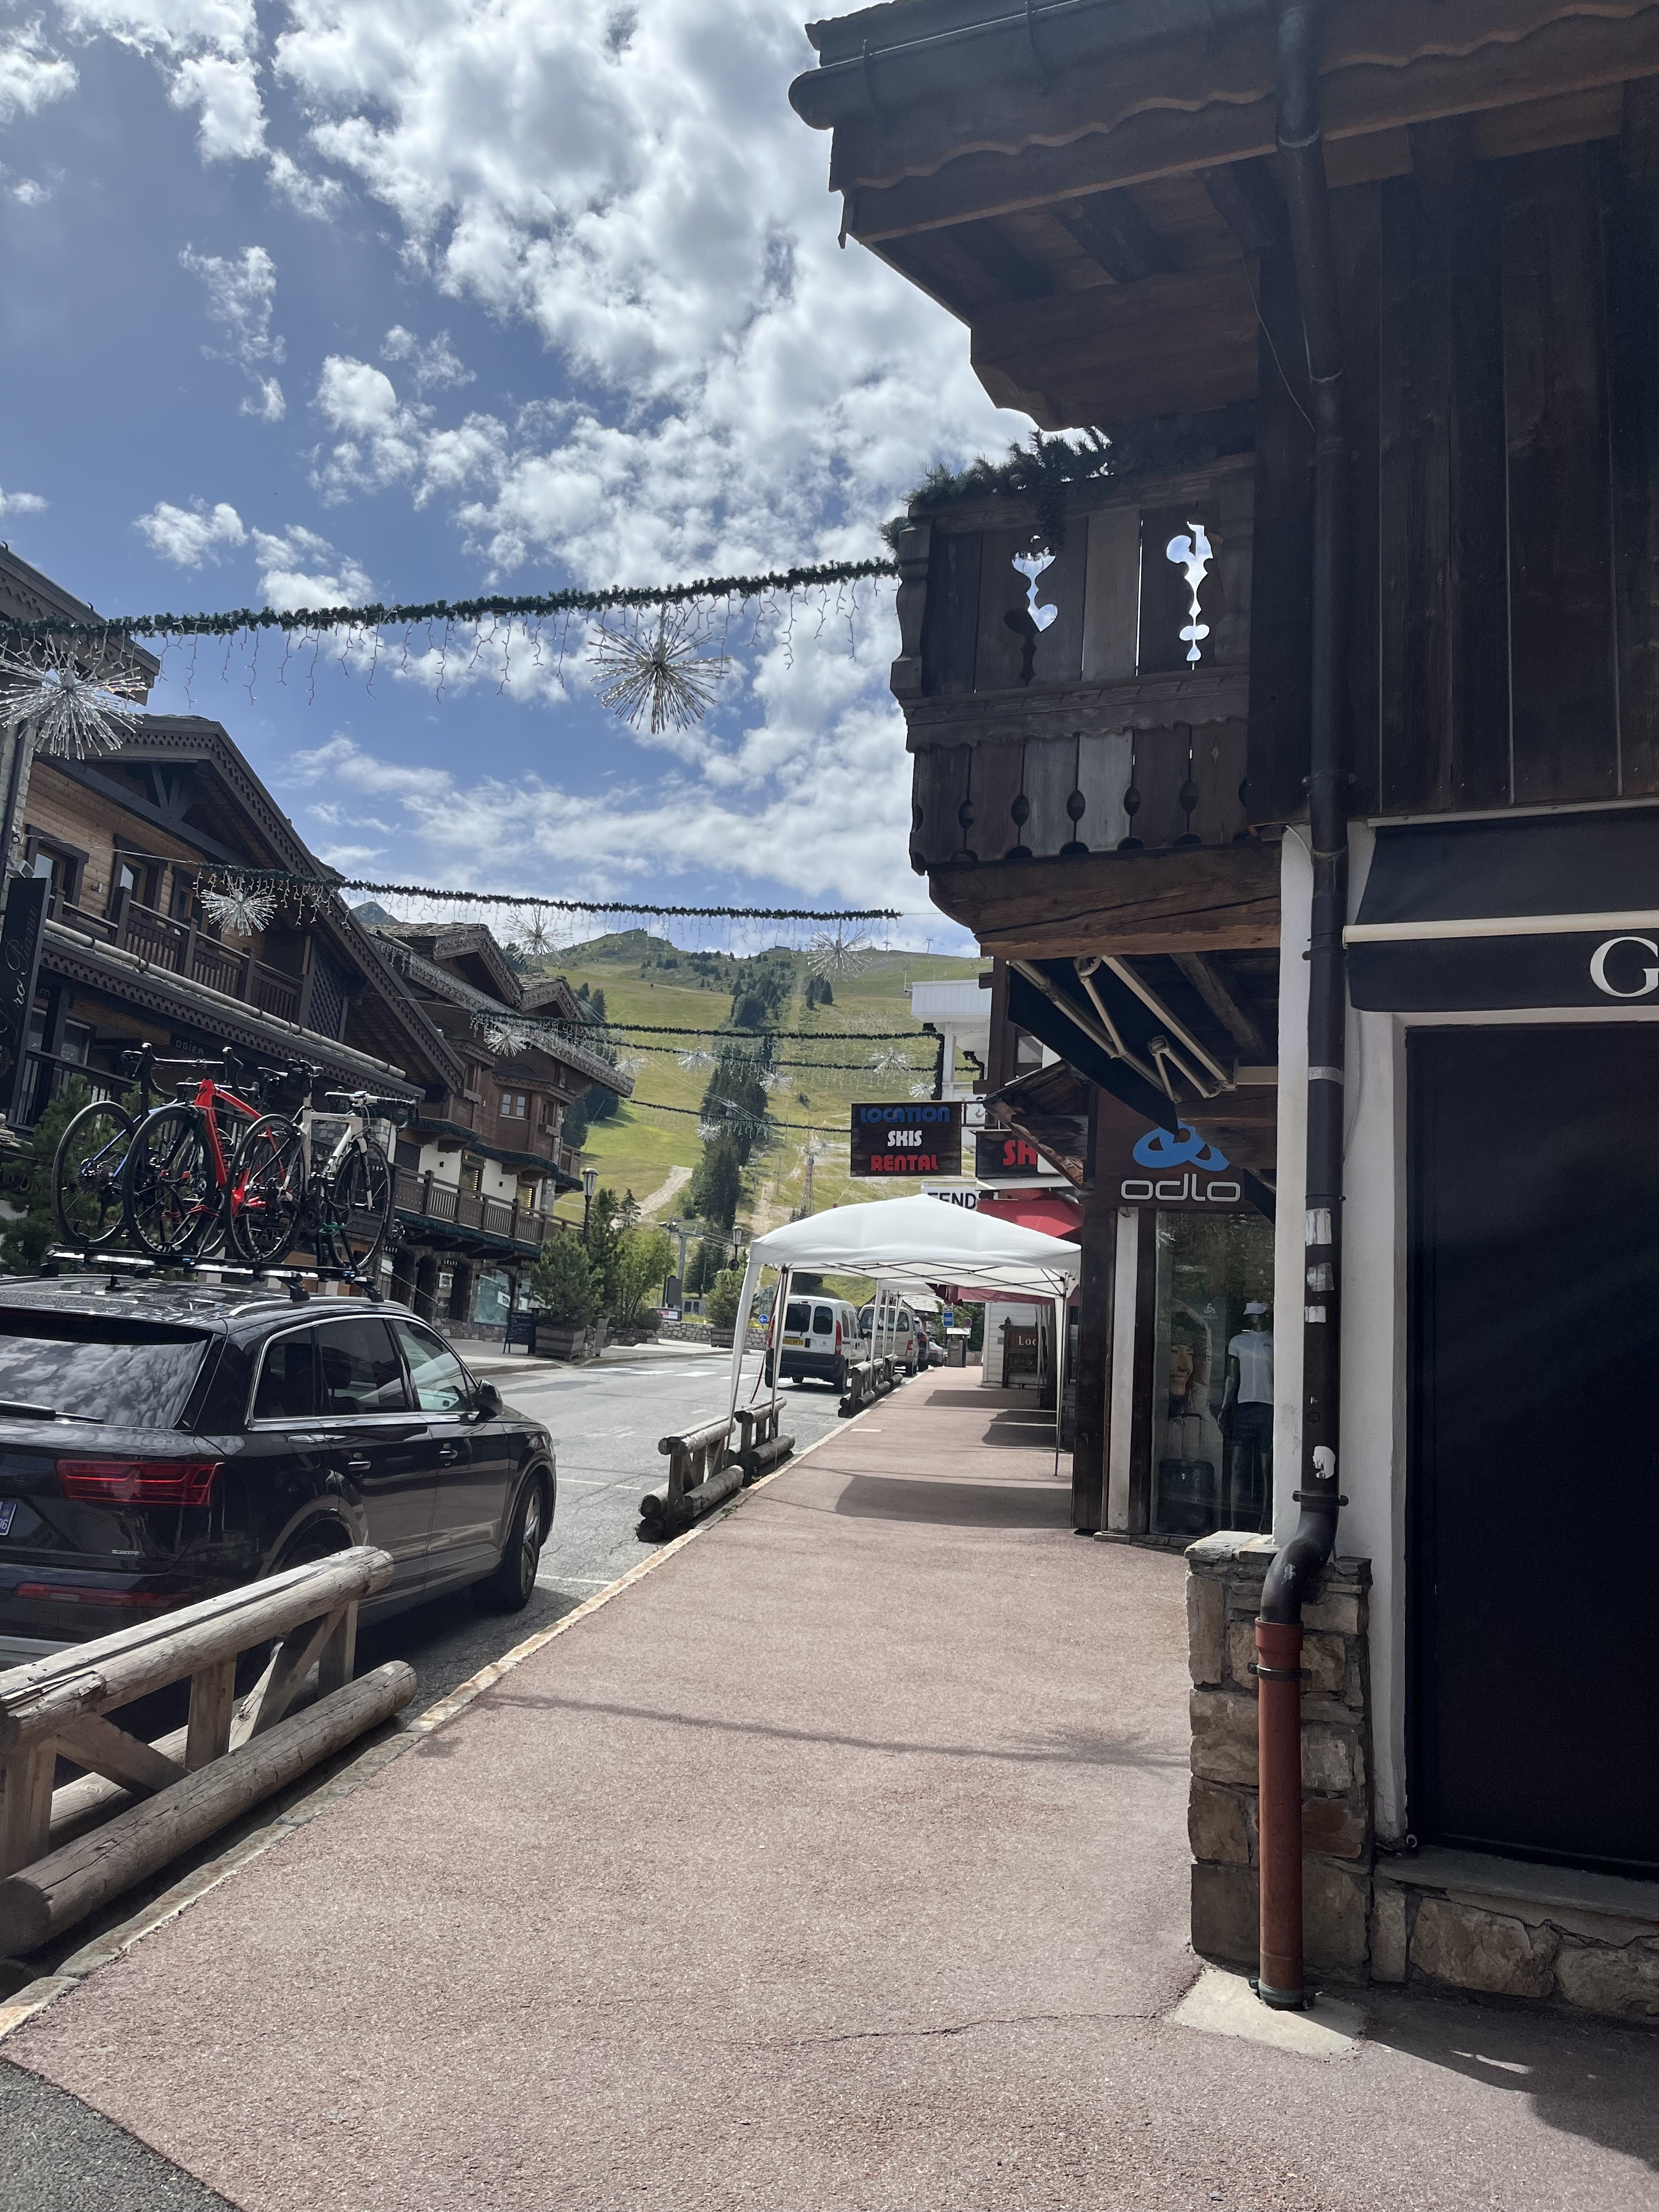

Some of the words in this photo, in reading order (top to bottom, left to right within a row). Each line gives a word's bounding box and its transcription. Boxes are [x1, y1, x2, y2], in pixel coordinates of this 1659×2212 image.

[860, 1106, 950, 1124] LOCATION
[887, 1130, 923, 1147] SKIS
[871, 1154, 939, 1171] RENTAL
[1121, 1173, 1241, 1202] odlo
[928, 1192, 977, 1209] END
[381, 1245, 398, 1254] GRAFF
